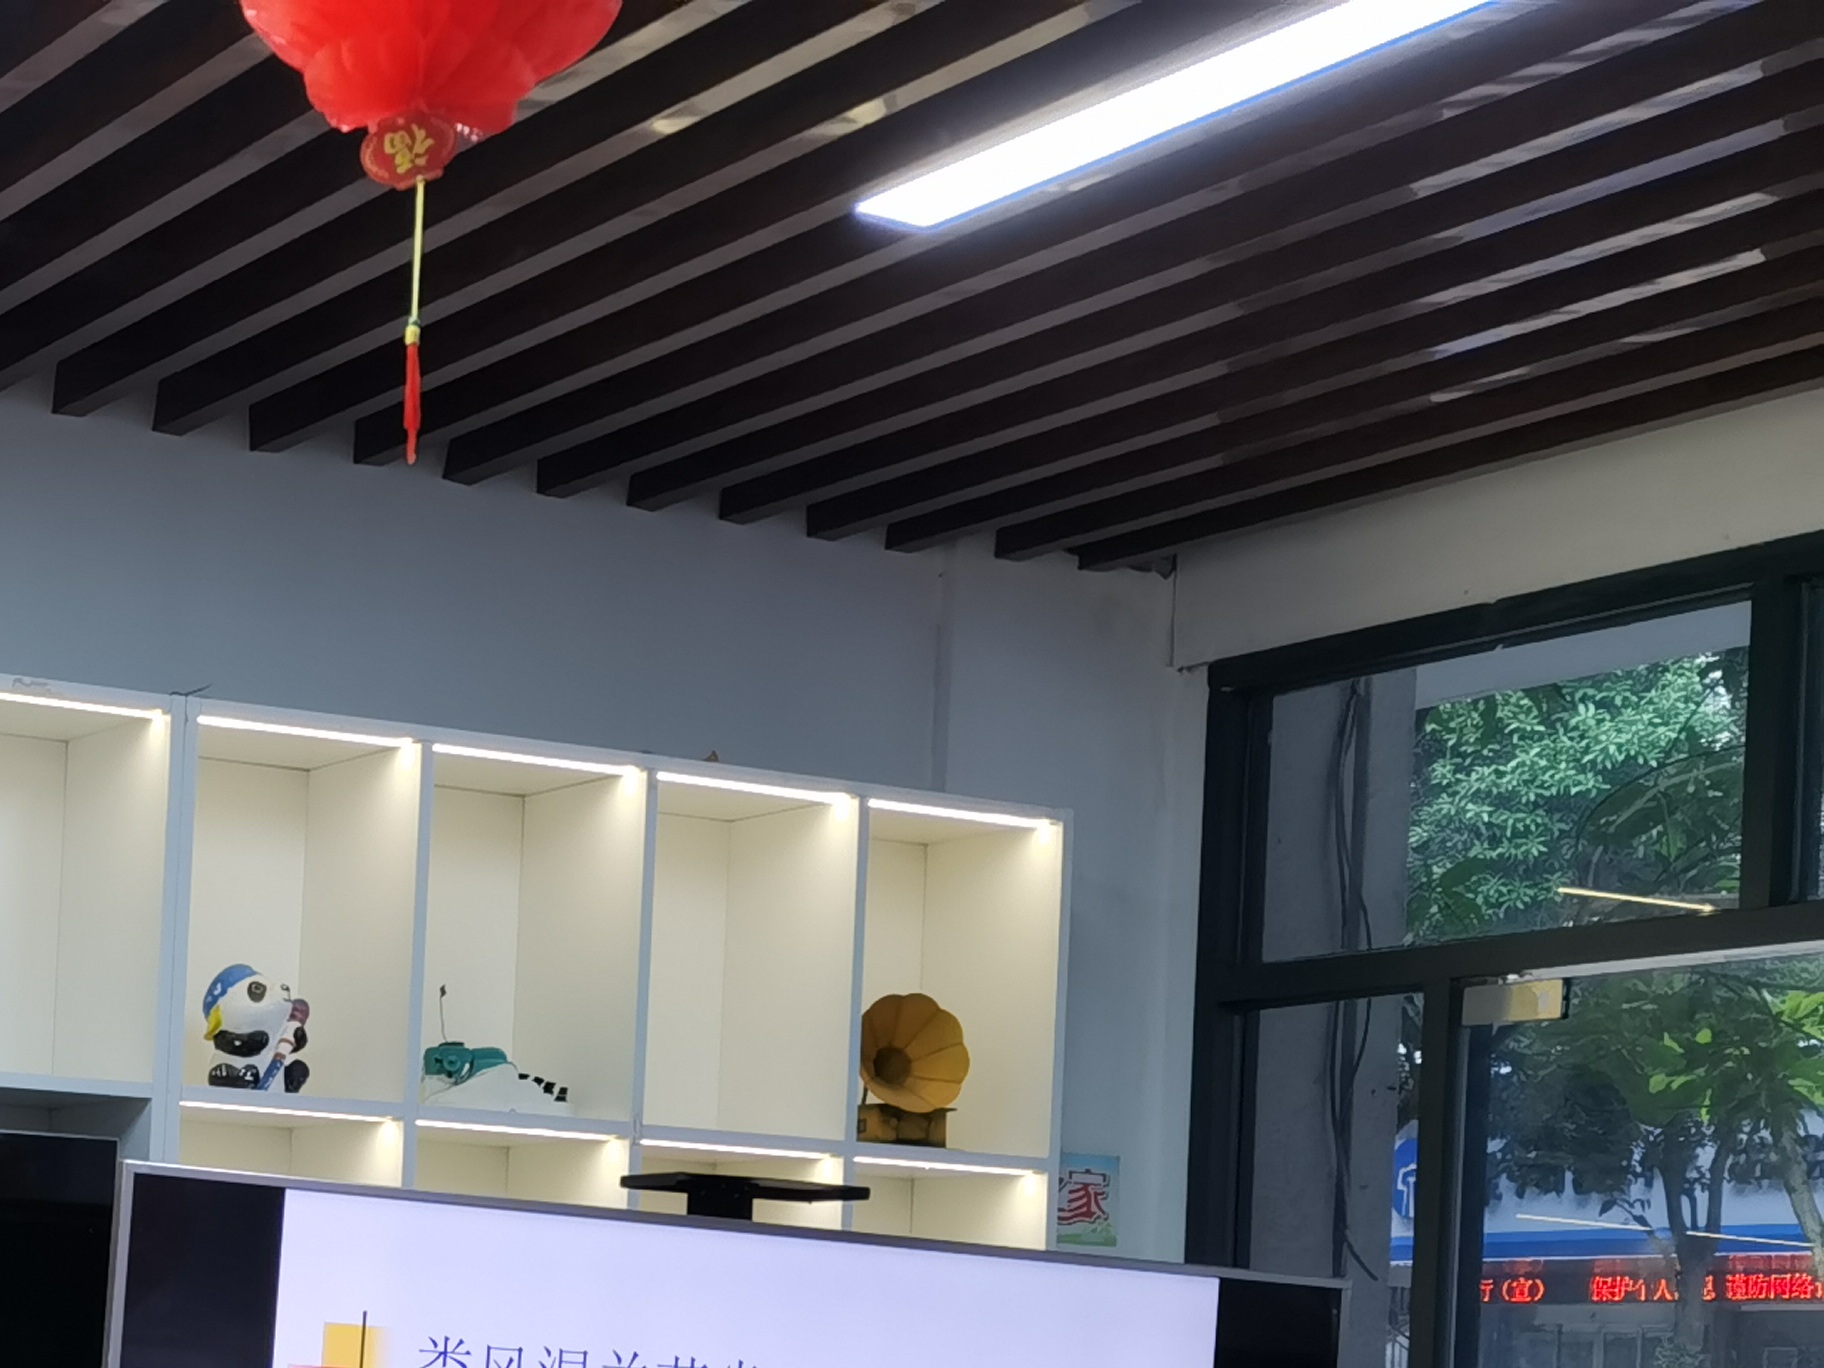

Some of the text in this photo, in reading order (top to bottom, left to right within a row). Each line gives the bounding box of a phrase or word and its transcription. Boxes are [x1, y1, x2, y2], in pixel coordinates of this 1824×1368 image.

[1057, 1168, 1110, 1225] 家
[1591, 1275, 1716, 1302] 保护个人息
